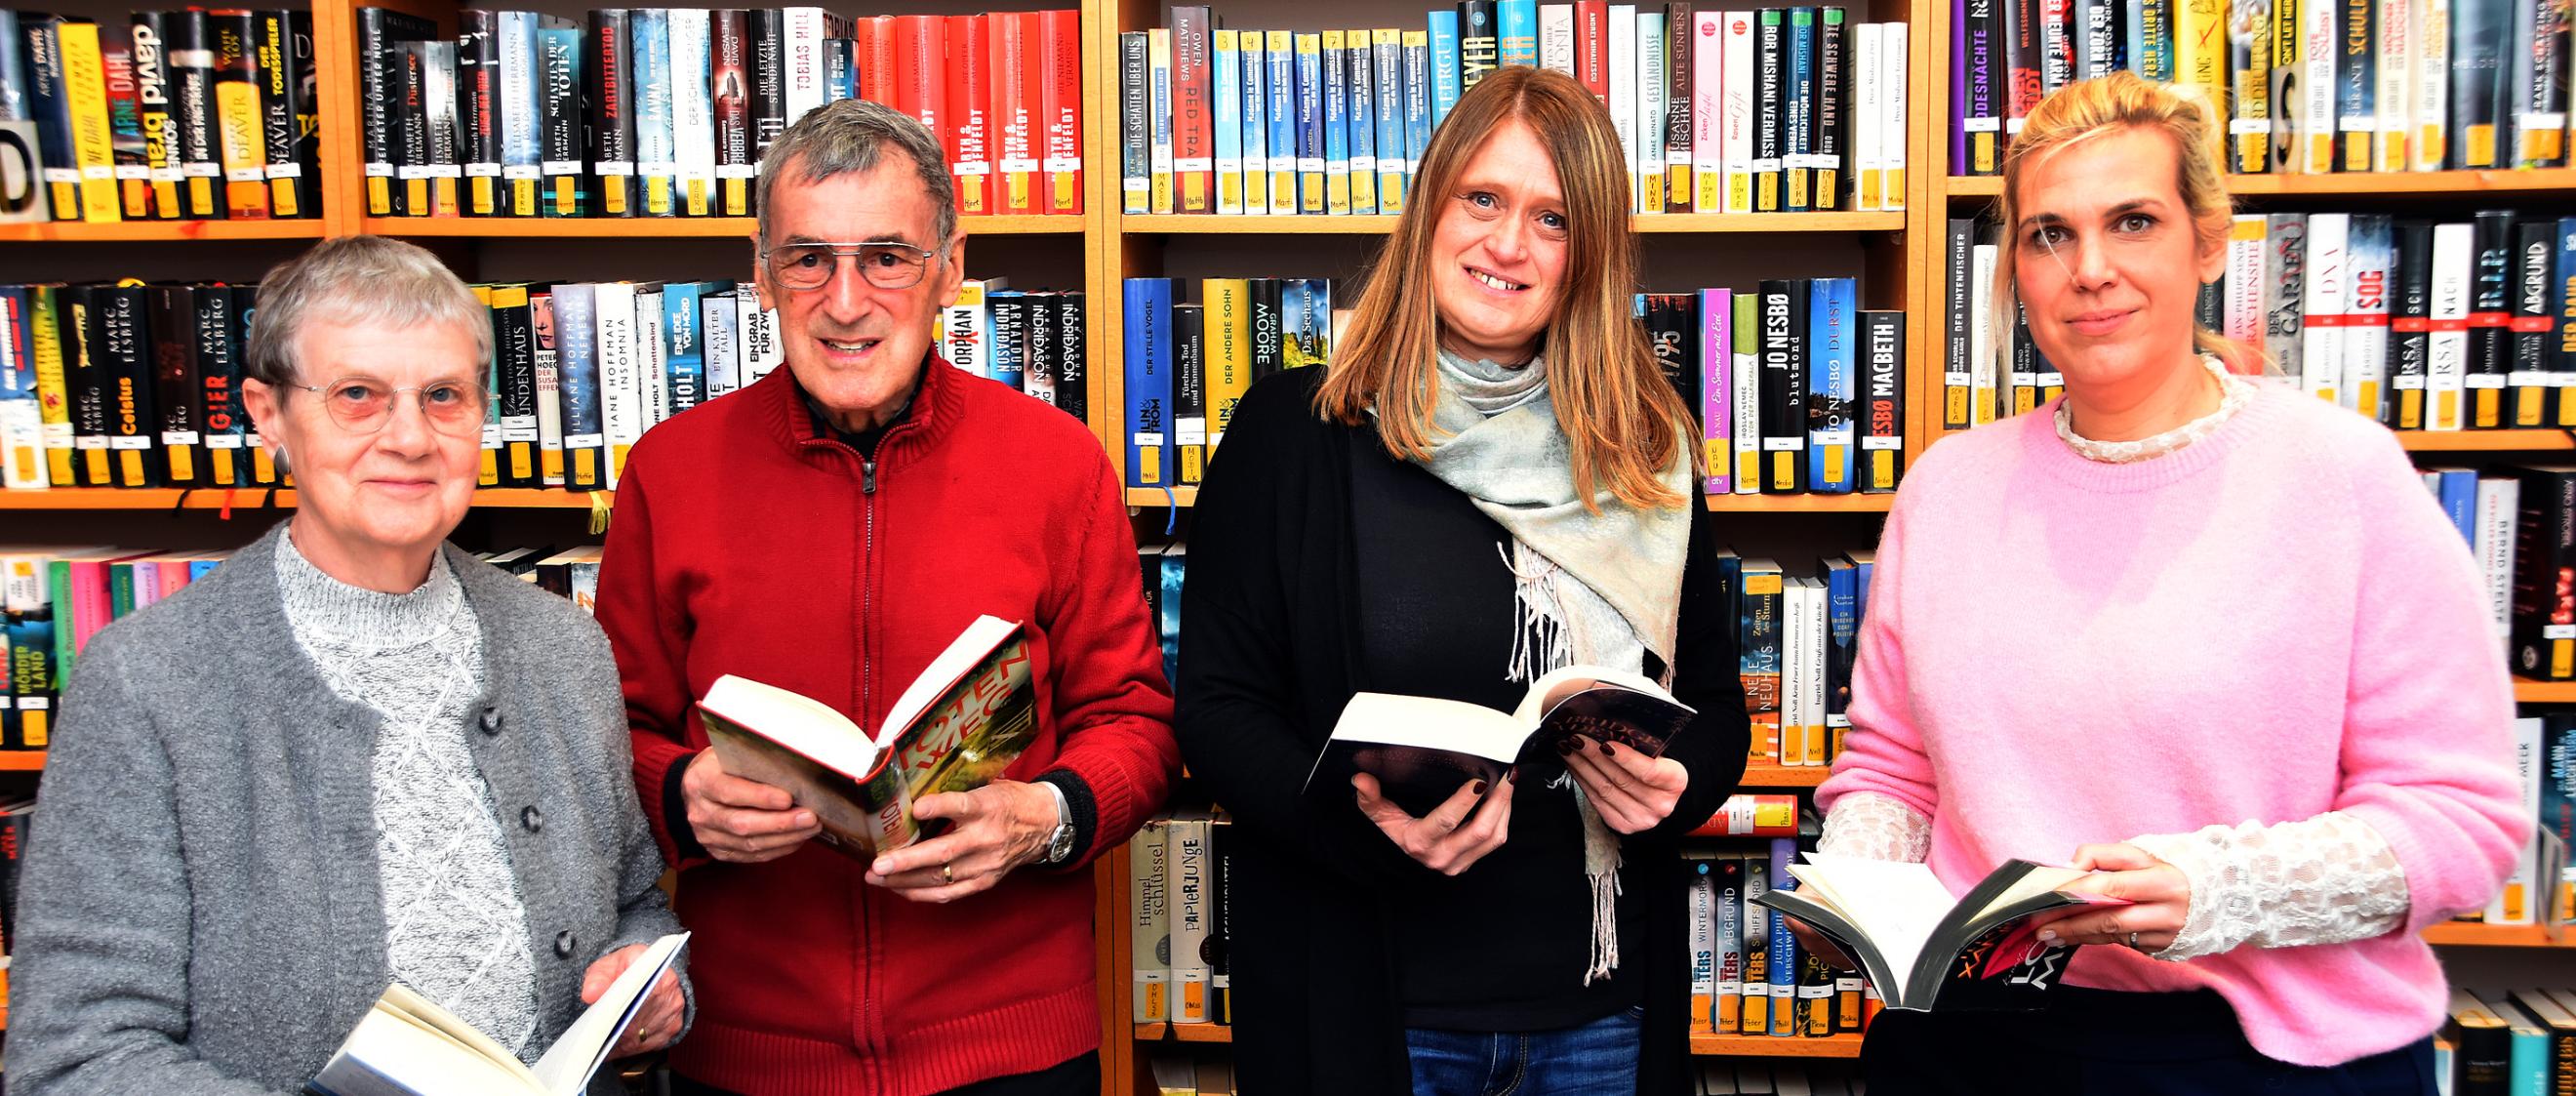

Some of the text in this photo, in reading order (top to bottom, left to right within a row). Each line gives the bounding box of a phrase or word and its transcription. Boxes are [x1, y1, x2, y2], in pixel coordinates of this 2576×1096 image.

[722, 20, 731, 66] HEWSON
[795, 12, 811, 91] TOBIAS HILL
[1127, 40, 1141, 60] UNS
[1180, 19, 1190, 82] MATTHEWS
[1193, 32, 1203, 66] OWEN
[2048, 15, 2064, 84] NEUNTE ARM
[2089, 6, 2104, 62] DER ZORN
[2142, 9, 2156, 47] DRITTE
[2283, 20, 2292, 39] LET
[132, 23, 170, 105] david
[260, 46, 269, 67] DER
[266, 18, 283, 96] TODESSPIELER
[407, 53, 419, 106] Düstersee
[508, 31, 520, 90] HERRMANN
[547, 36, 560, 117] SCHATTEN DER
[557, 44, 572, 100] TOTEN
[601, 26, 619, 118] ZARTBITTERTOD
[757, 40, 769, 96] DIE LETZTE
[767, 31, 780, 104] STUNDE NAHT
[1126, 61, 1141, 87] ÜBER
[1434, 30, 1454, 112] LEERGUT
[1590, 39, 1598, 82] MIHAILESCU
[1643, 34, 1660, 103] GESTÄNDNISSE
[1676, 62, 1686, 90] ALTE
[1762, 52, 1777, 102] MISHANI
[1796, 42, 1807, 74] MISHANI
[1824, 43, 1838, 126] SCHWERE HAND
[104, 49, 140, 137] ARNE DAHL
[373, 28, 387, 143] METER UNTER NULL
[469, 91, 479, 130] Herrmann
[1128, 87, 1142, 131] SCHATTEN
[1186, 88, 1197, 118] RED
[1790, 101, 1798, 118] EINES
[233, 97, 253, 161] DEAVER
[272, 103, 292, 165] DEAVER
[366, 93, 376, 148] MARINA
[730, 109, 742, 127] DAS
[1130, 132, 1143, 147] DIE
[1798, 81, 1810, 151] DIE MÖGLICHKEIT
[1954, 233, 1966, 332] DER TINTENFISCHER
[2281, 234, 2303, 337] GARTEN
[2321, 248, 2339, 294] DNA
[2356, 270, 2384, 309] SOG
[2479, 248, 2508, 308] R.I.P.
[2524, 240, 2550, 314] ABGRUND
[104, 307, 120, 353] MARC
[117, 297, 136, 362] ELSBERG
[200, 308, 214, 354] MARC
[211, 298, 228, 363] ELSBERG
[565, 302, 578, 370] HOFFMAN
[576, 302, 589, 359] NEMESIS
[672, 311, 684, 355] EINE IDEE
[680, 297, 692, 349] VON MORD
[711, 308, 721, 372] EIN KALTER
[720, 328, 729, 353] FALL
[748, 313, 759, 363] EIN GRAB
[758, 333, 771, 354] FÜR
[1011, 304, 1023, 372] ARNALDUR
[1145, 299, 1154, 375] DER STILLE VOGEL
[1224, 288, 1233, 385] DER ANDERE SOHN
[1257, 303, 1270, 364] MOORE
[1269, 312, 1278, 354] GRAHAM
[1302, 291, 1313, 353] Das Seehaus
[1767, 293, 1790, 371] JO NESBØ
[1828, 298, 1840, 350] DURST
[2266, 310, 2280, 337] DER
[605, 319, 617, 387] HOFFMAN
[617, 318, 630, 390] INSOMNIA
[649, 321, 660, 381] Schattenkind
[1181, 344, 1191, 398] Türchen, Tod
[1189, 335, 1199, 406] und Tannenbaum
[1711, 311, 1723, 404] Ein Sommer mit Esel
[1789, 336, 1801, 406] blutmond
[1872, 323, 1894, 397] MACBETH
[119, 377, 138, 436] Celsius
[205, 375, 232, 429] GIER
[503, 393, 516, 416] Das
[675, 365, 696, 407] HOLT
[1828, 359, 1842, 411] NESBØ
[1752, 609, 1762, 637] Zeiten
[14, 646, 32, 694] MÖRDER
[30, 651, 48, 689] LAND
[1748, 661, 1760, 696] NELE
[1760, 646, 1774, 711] NEUHAUS
[1814, 683, 1823, 706] Ingrid
[899, 640, 1030, 771] TOTEN
[916, 685, 1015, 770] WEG
[2552, 745, 2565, 778] MANN
[1138, 878, 1152, 927] Himmel
[1147, 843, 1164, 916] schlüssel
[1698, 878, 1708, 944] WINTERMORD
[1723, 887, 1736, 947] ABGRUND
[1775, 937, 1784, 965] JULIA
